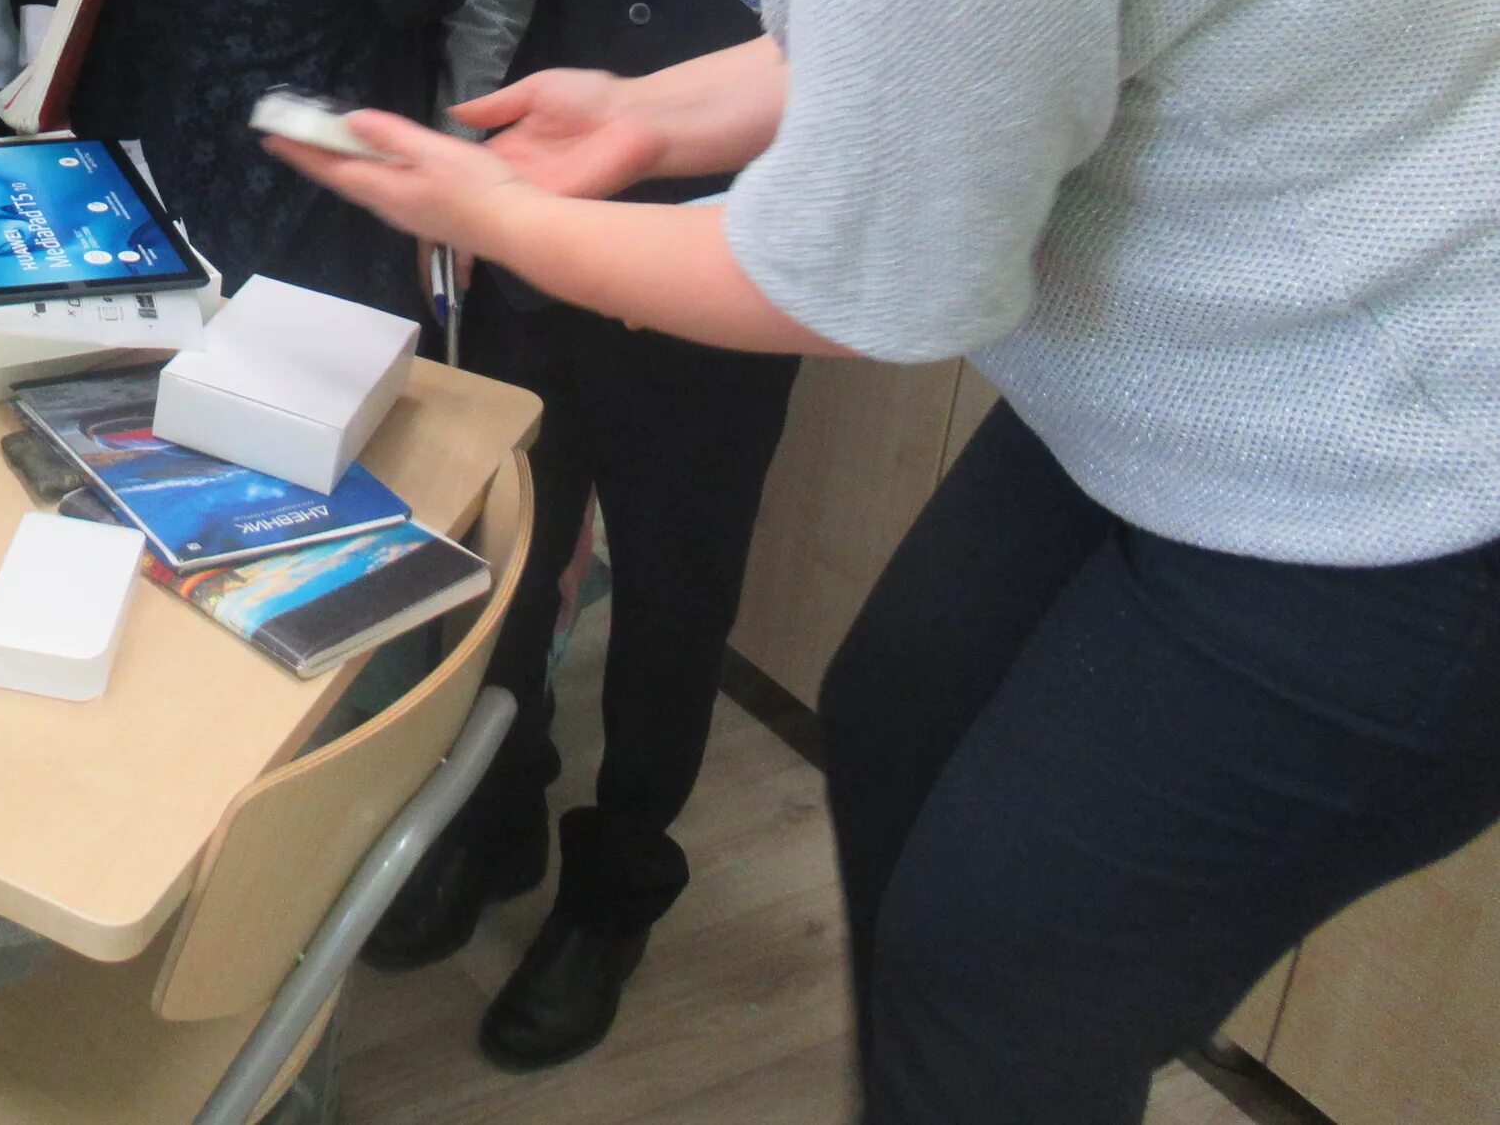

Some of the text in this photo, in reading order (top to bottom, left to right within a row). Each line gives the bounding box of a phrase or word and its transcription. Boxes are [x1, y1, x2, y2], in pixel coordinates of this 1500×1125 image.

[10, 182, 72, 269] MediaPad T5 10
[3, 229, 38, 271] HUAWEI
[234, 505, 329, 535] ДНЕВНИК
